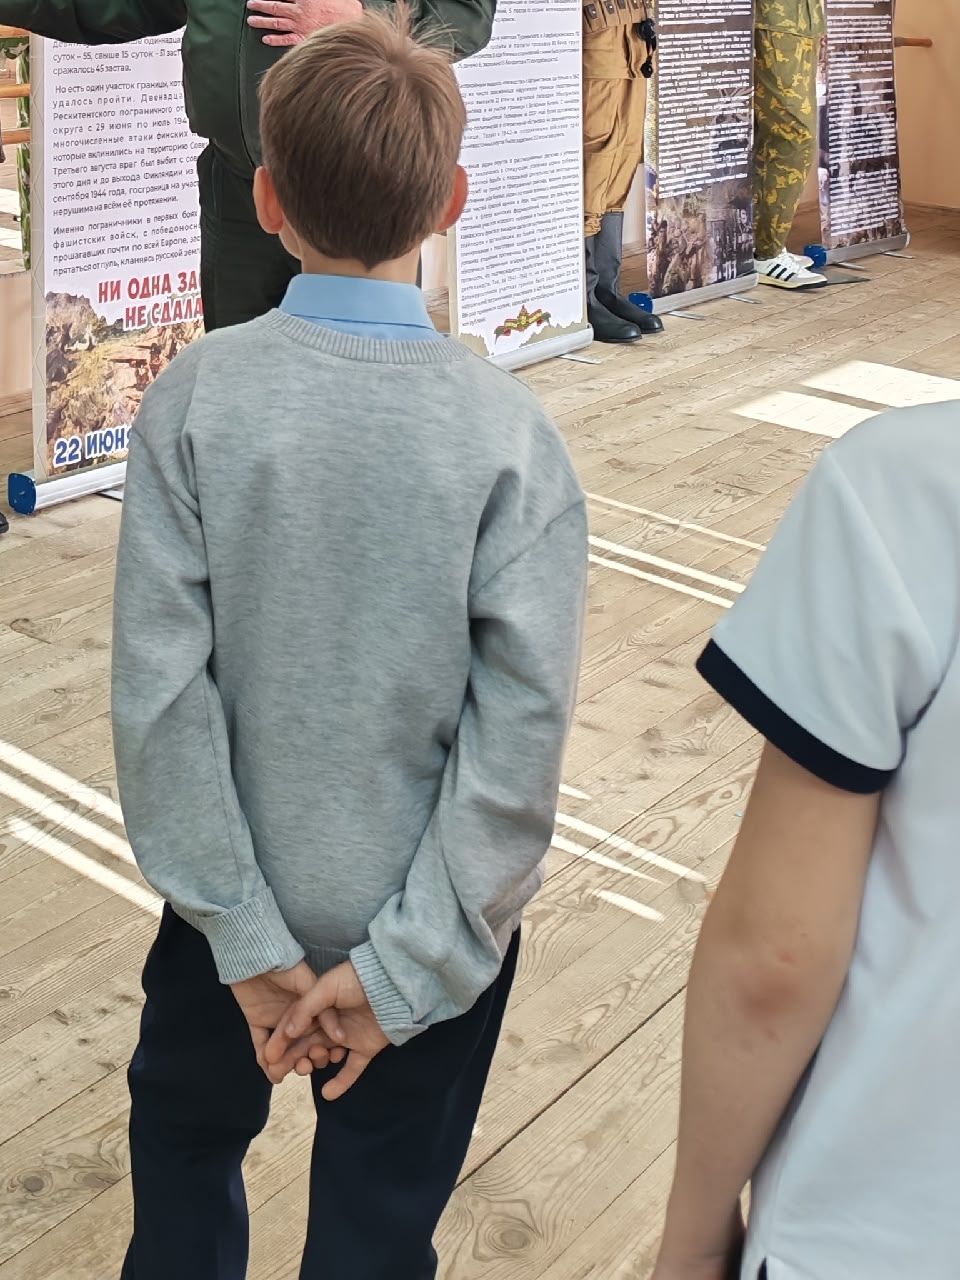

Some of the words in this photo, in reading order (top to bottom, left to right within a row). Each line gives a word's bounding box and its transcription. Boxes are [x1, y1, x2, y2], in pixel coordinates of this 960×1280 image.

[53, 53, 74, 63] суток
[131, 51, 153, 59] суток
[53, 66, 95, 76] сражалось
[86, 84, 104, 92] один
[106, 83, 134, 93] участок
[53, 99, 92, 109] удалось
[98, 96, 135, 106] пройти.
[120, 107, 172, 117] пограничного
[53, 126, 83, 136] округа
[109, 122, 132, 130] июня
[53, 136, 124, 148] многочисленные
[129, 133, 153, 142] атаки
[157, 131, 188, 141] финских
[53, 152, 86, 162] которые
[88, 146, 133, 158] вклинились
[147, 143, 188, 153] территорию
[53, 166, 88, 177] Третьего
[91, 162, 117, 172] августа
[120, 161, 137, 169] враг
[141, 159, 155, 167] был
[53, 180, 74, 189] этого
[77, 179, 91, 187] дня
[112, 174, 140, 184] выхода
[144, 169, 183, 179] Финляндии
[53, 190, 89, 203] сентября
[91, 188, 106, 198] 1944
[109, 187, 126, 197] года,
[129, 182, 169, 195] госграница
[53, 207, 93, 217] нерушима
[104, 200, 121, 210] всём
[134, 195, 178, 207] протяжении.
[53, 224, 84, 235] Именно
[88, 217, 142, 231] пограничники
[154, 212, 178, 223] первых
[53, 235, 106, 250] фашистских
[110, 231, 138, 240] войск,
[53, 248, 106, 263] прошагавших
[107, 245, 129, 255] почти
[144, 241, 159, 250] всей
[161, 237, 188, 247] Европе,
[53, 263, 91, 276] прятаться
[121, 255, 154, 266] кланяясь
[156, 249, 182, 262] русской
[99, 280, 122, 303] НИ
[128, 273, 171, 299] ОДНА
[178, 271, 201, 293] ЗА
[125, 305, 147, 329] НЕ
[152, 297, 203, 323] СДАЛА
[55, 439, 80, 464] 22
